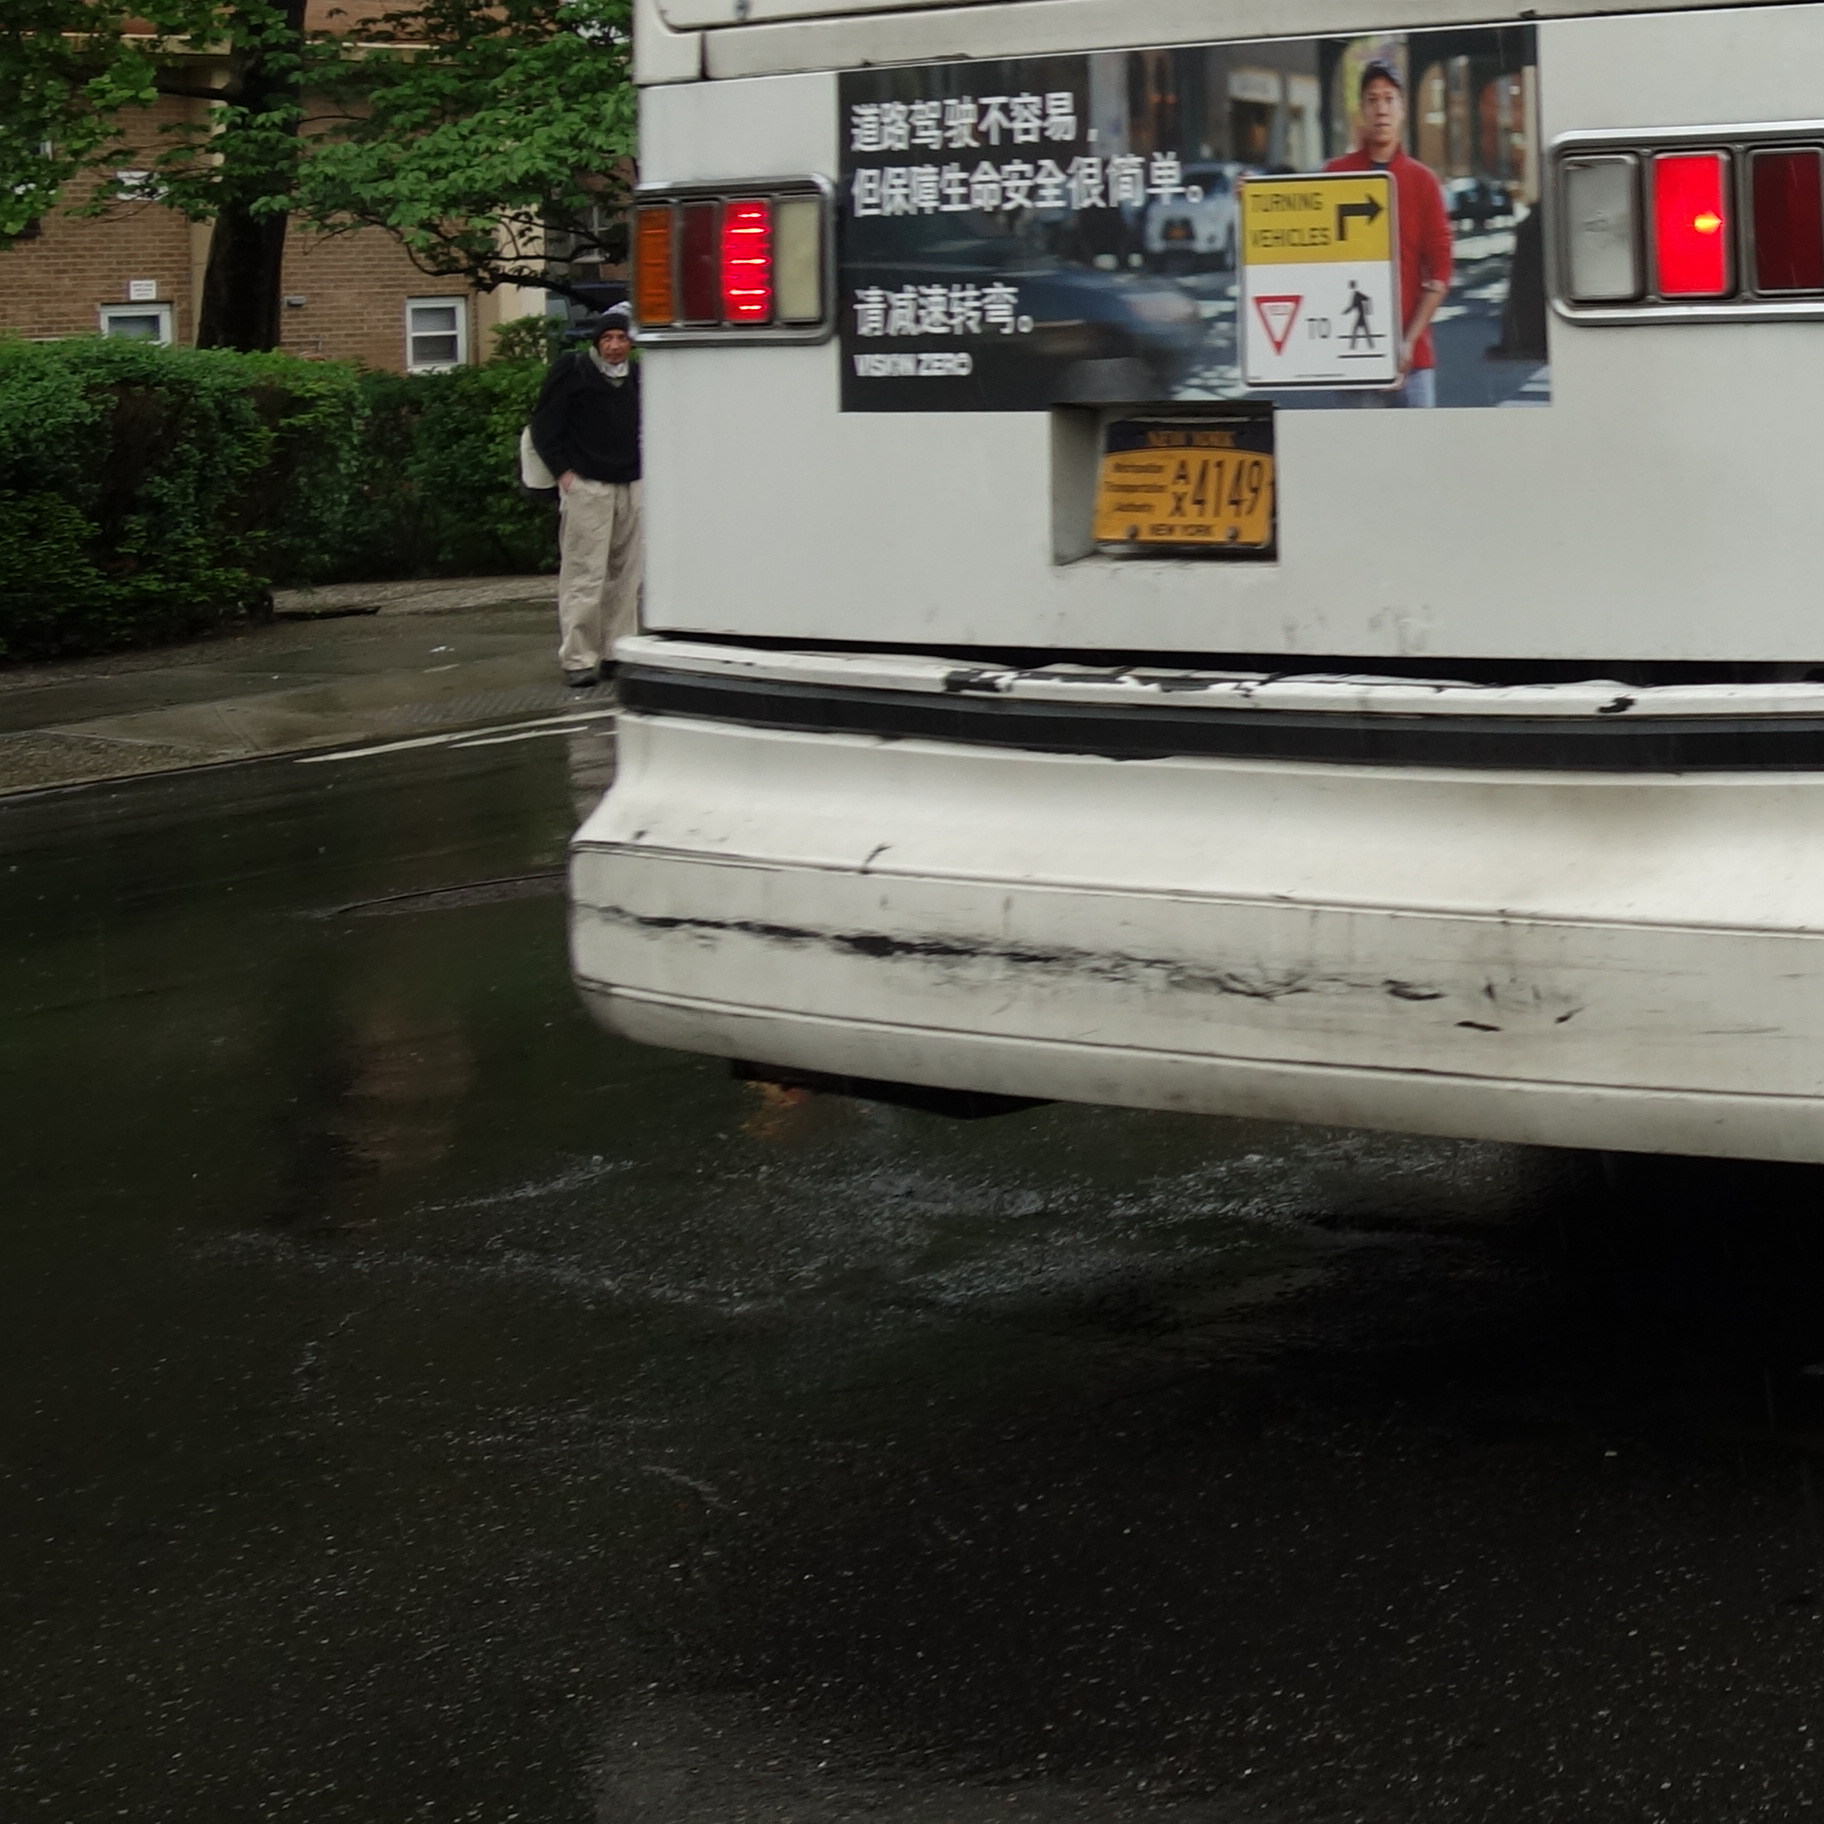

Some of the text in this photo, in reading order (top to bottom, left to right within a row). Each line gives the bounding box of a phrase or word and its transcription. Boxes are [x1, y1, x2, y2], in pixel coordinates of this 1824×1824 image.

[1250, 192, 1324, 213] TURNING
[1252, 227, 1330, 248] VEHICLES
[1305, 317, 1333, 340] TO
[853, 352, 973, 376] VISION ZERO
[1192, 459, 1265, 517] 4149
